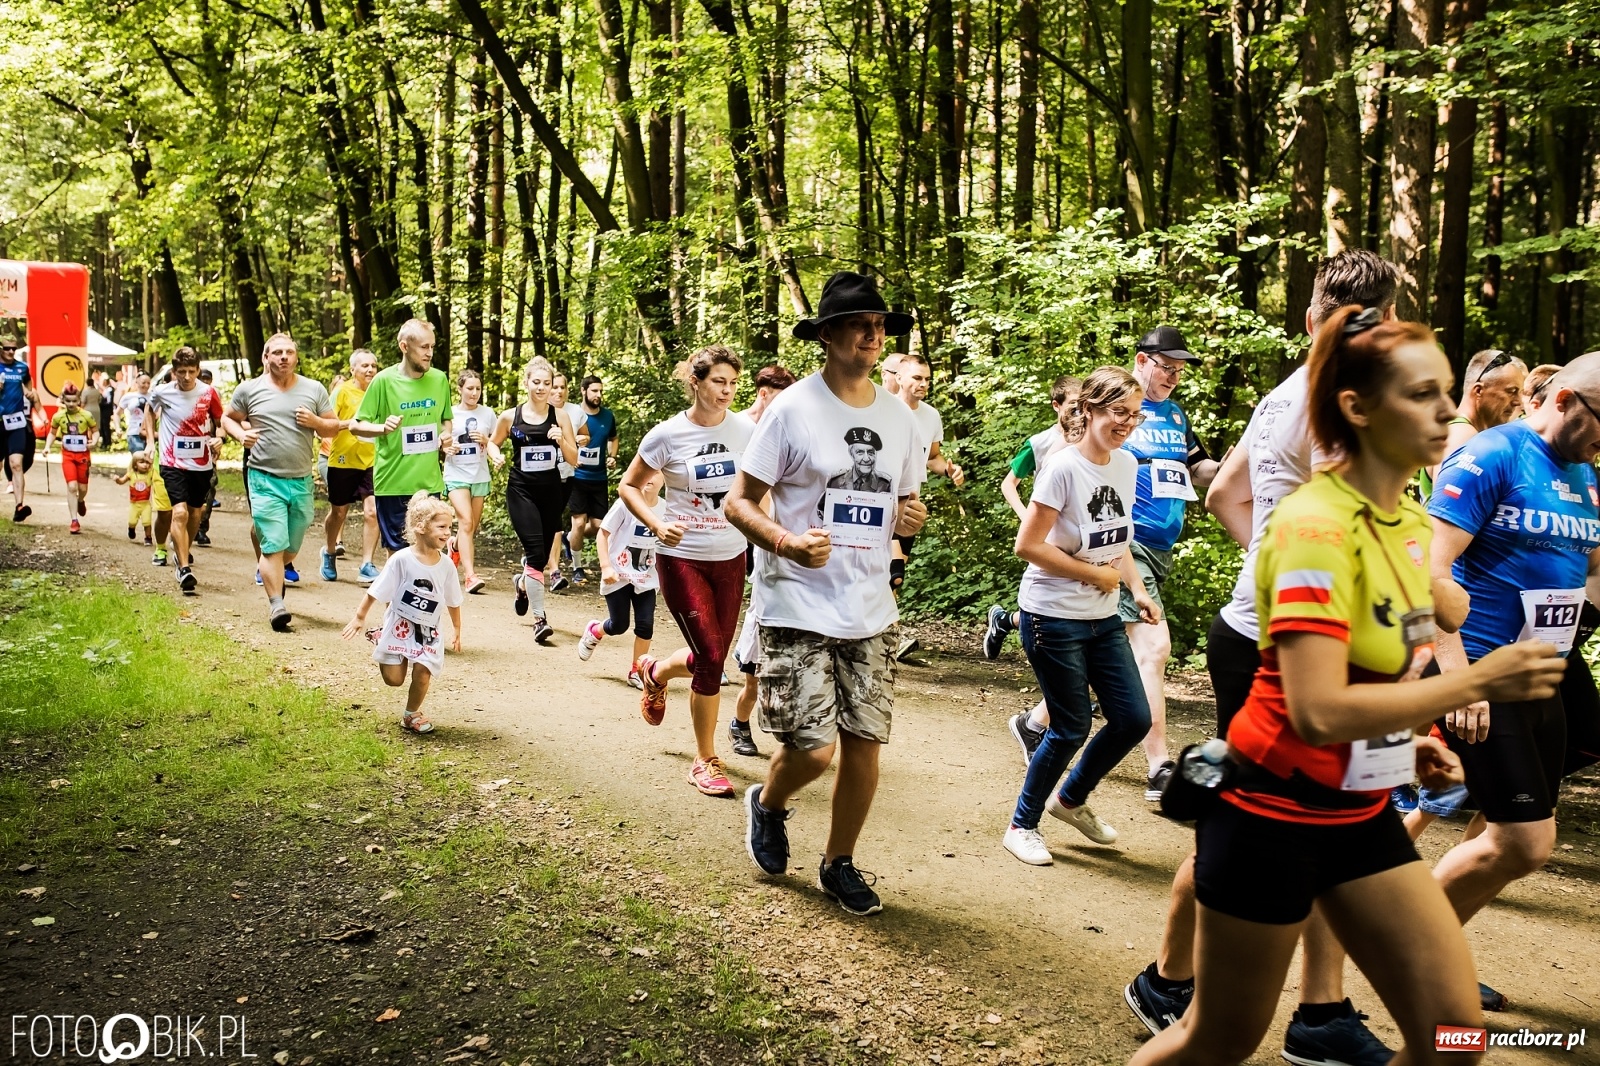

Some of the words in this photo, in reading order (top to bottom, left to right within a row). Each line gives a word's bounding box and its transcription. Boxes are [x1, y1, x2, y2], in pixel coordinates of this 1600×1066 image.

[400, 399, 436, 410] CLASSEN
[414, 433, 427, 442] 86
[531, 452, 545, 461] 46
[705, 463, 725, 477] 28
[1166, 470, 1182, 483] 84
[848, 506, 871, 524] 10
[1100, 529, 1118, 545] 11
[410, 596, 429, 610] 26
[1543, 606, 1575, 626] 112
